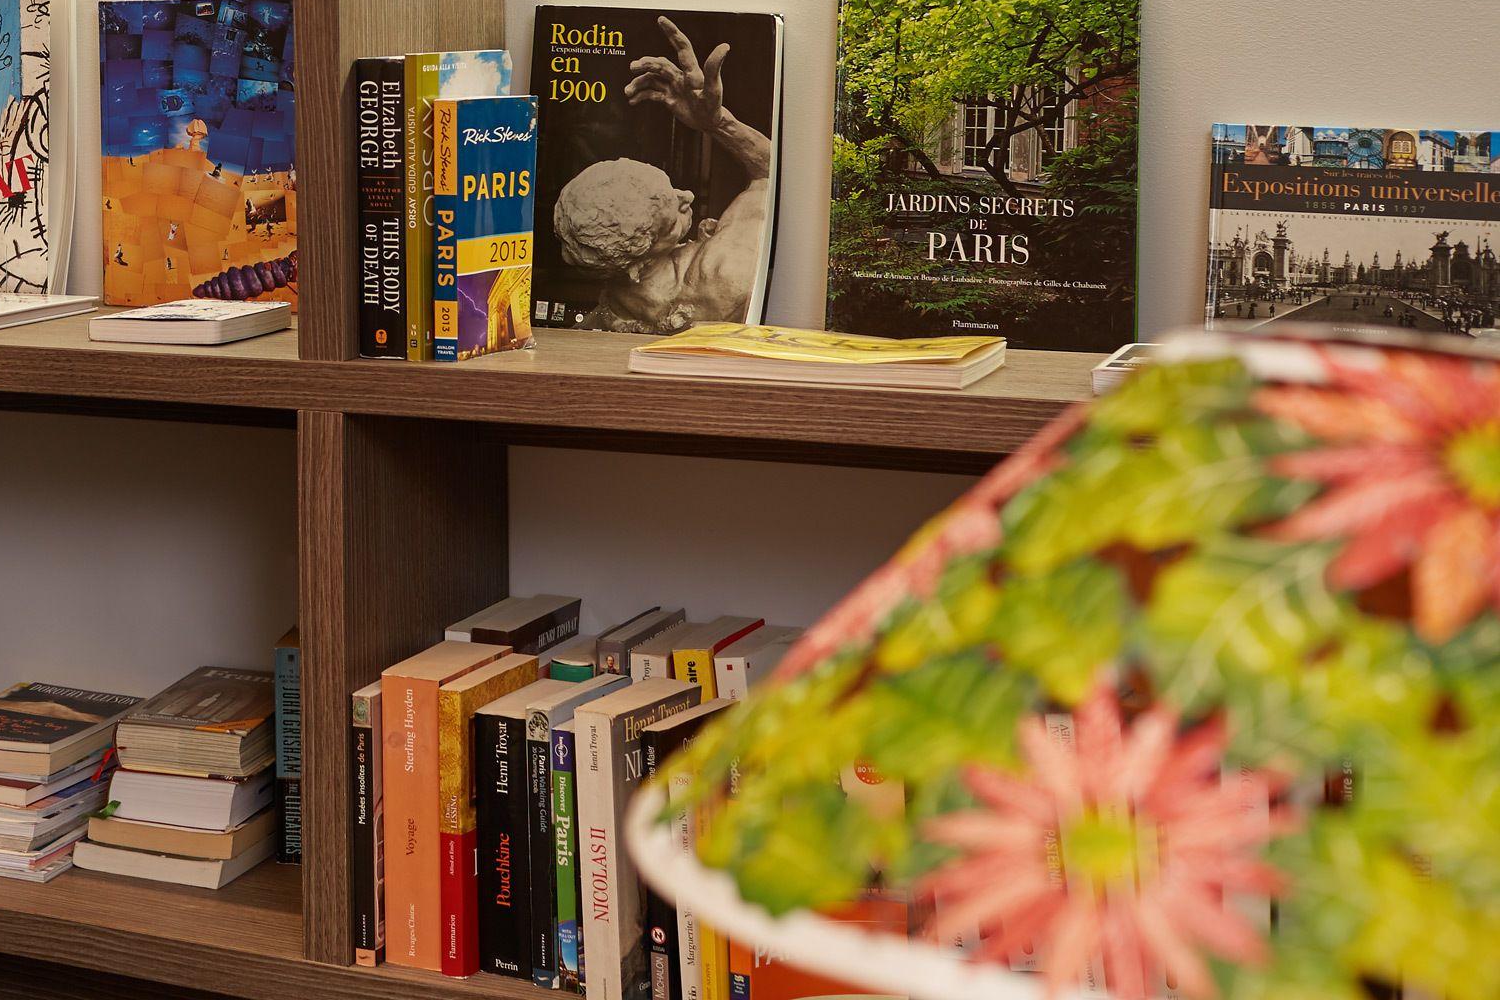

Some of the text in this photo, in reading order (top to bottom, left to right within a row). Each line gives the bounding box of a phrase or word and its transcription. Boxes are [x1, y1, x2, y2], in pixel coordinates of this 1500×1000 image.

[550, 23, 624, 48] Rodin
[551, 46, 590, 54] L'exposition
[603, 47, 626, 56] l'Alma
[422, 63, 438, 72] GUIDA
[551, 56, 580, 74] en
[549, 79, 606, 103] 1900
[360, 80, 379, 168] GEORGE
[382, 80, 402, 169] Elizabeth
[440, 108, 452, 145] Rick
[462, 127, 492, 146] Rick
[408, 106, 417, 229] ORSAY GUIDA ALLA VISITA
[464, 170, 531, 202] PARIS
[1222, 172, 1500, 204] Expositions universelle
[886, 193, 1075, 218] JARDINS SECRETS
[1343, 202, 1386, 212] PARIS
[969, 218, 988, 230] DE
[364, 224, 380, 305] OF DEATH
[438, 210, 455, 287] PARIS
[490, 239, 527, 263] 2013
[926, 232, 1030, 265] PARIS
[382, 218, 400, 314] THIS BODY
[920, 274, 940, 282] Bruno
[942, 274, 950, 282] de
[988, 276, 1032, 289] Photographies
[1043, 279, 1062, 288] Gilles
[1062, 280, 1071, 288] de
[442, 307, 450, 332] 2013
[952, 320, 1000, 330] Flammarion
[538, 616, 579, 648] HENRI TROYAT
[29, 684, 138, 705] DOROTHY ALLISON
[282, 686, 300, 715] JOHN
[404, 688, 416, 773] Sterling Hayden
[283, 720, 300, 774] GRISHAM
[496, 721, 510, 795] Henri Troyat
[539, 746, 546, 754] A
[590, 726, 598, 772] Henri Troyat
[646, 745, 656, 766] Maier
[356, 732, 366, 825] Musées insolites de Paris
[538, 754, 546, 775] Paris
[538, 776, 546, 808] Walking
[285, 795, 302, 855] LITIGATORS
[450, 795, 458, 830] LESSING
[406, 818, 418, 856] Voyage
[556, 814, 572, 866] Paris
[496, 832, 512, 908] Pouchkine
[590, 826, 610, 922] NICOLAS II
[686, 920, 696, 966] Marguerite
[495, 958, 519, 972] Perrin
